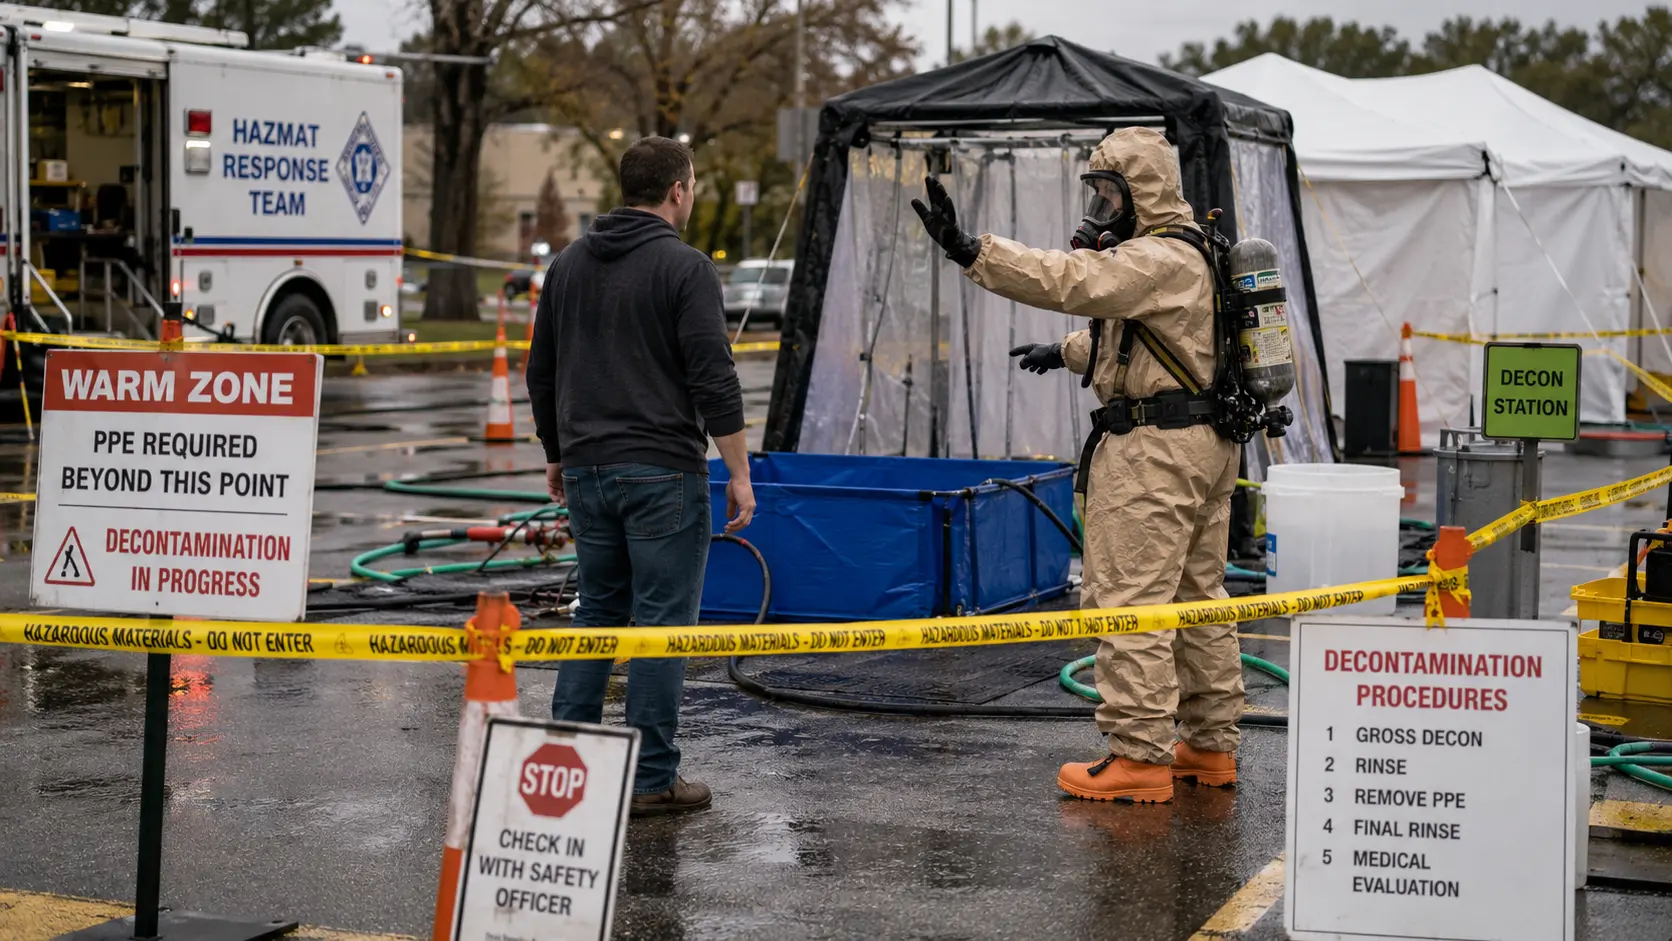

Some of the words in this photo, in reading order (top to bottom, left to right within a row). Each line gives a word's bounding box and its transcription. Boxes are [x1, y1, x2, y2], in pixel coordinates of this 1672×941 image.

[233, 118, 320, 148] HAZMAT
[223, 154, 329, 182] RESPONSE
[249, 190, 305, 216] TEAM
[61, 369, 175, 401] WARM
[188, 371, 293, 404] ZONE
[1501, 369, 1563, 387] DECON
[1494, 398, 1568, 416] STATION
[94, 430, 135, 454] PPE
[142, 432, 257, 459] REQUIRED
[62, 466, 151, 492] BEYOND
[160, 470, 211, 495] THIS
[219, 472, 289, 498] POINT
[106, 528, 291, 561] DECONTAMINATION
[131, 566, 150, 591] IN
[158, 568, 260, 597] PROGRESS
[1237, 600, 1289, 619] MATERIALS
[1296, 597, 1311, 612] DO
[1312, 594, 1332, 609] NOT
[24, 624, 109, 646] HAZARDOUS
[112, 628, 192, 649] MATERIALS
[207, 631, 228, 650] DO
[232, 631, 261, 651] NOT
[266, 632, 315, 652] ENTER
[666, 635, 736, 653] HAZARDOUS
[739, 632, 799, 651] MATERIALS
[811, 632, 828, 649] DO
[829, 631, 851, 648] NOT
[852, 629, 885, 647] ENTER
[921, 625, 979, 644] HAZARDOUS
[981, 621, 1032, 641] MATERIALS
[1040, 620, 1054, 637] DO
[1106, 615, 1138, 632] ENTER
[369, 635, 455, 655] HAZARDOUS
[525, 637, 545, 654] DO
[546, 636, 575, 654] NOT
[576, 636, 619, 654] ENTER
[1324, 649, 1542, 678] DECONTAMINATION
[1356, 684, 1508, 711] PROCEDURES
[1326, 726, 1333, 741] 1
[1356, 727, 1416, 745] GROSS
[1422, 729, 1482, 747] DECON
[1324, 757, 1335, 772] 2
[1355, 758, 1407, 775] RINSE
[522, 762, 585, 799] STOP
[1324, 787, 1334, 802] 3
[1355, 788, 1427, 807] REMOVE
[1432, 792, 1466, 809] PPE
[499, 828, 561, 856] CHECK
[566, 837, 585, 857] IN
[1323, 818, 1333, 833] 4
[1354, 819, 1403, 837] FINAL
[1408, 822, 1461, 840] RINSE
[479, 855, 524, 880] WITH
[530, 862, 599, 889] SAFETY
[1322, 849, 1332, 864] 5
[1353, 850, 1431, 869] MEDICAL
[1352, 876, 1460, 897] EVALUATION
[495, 887, 572, 916] OFFICER
